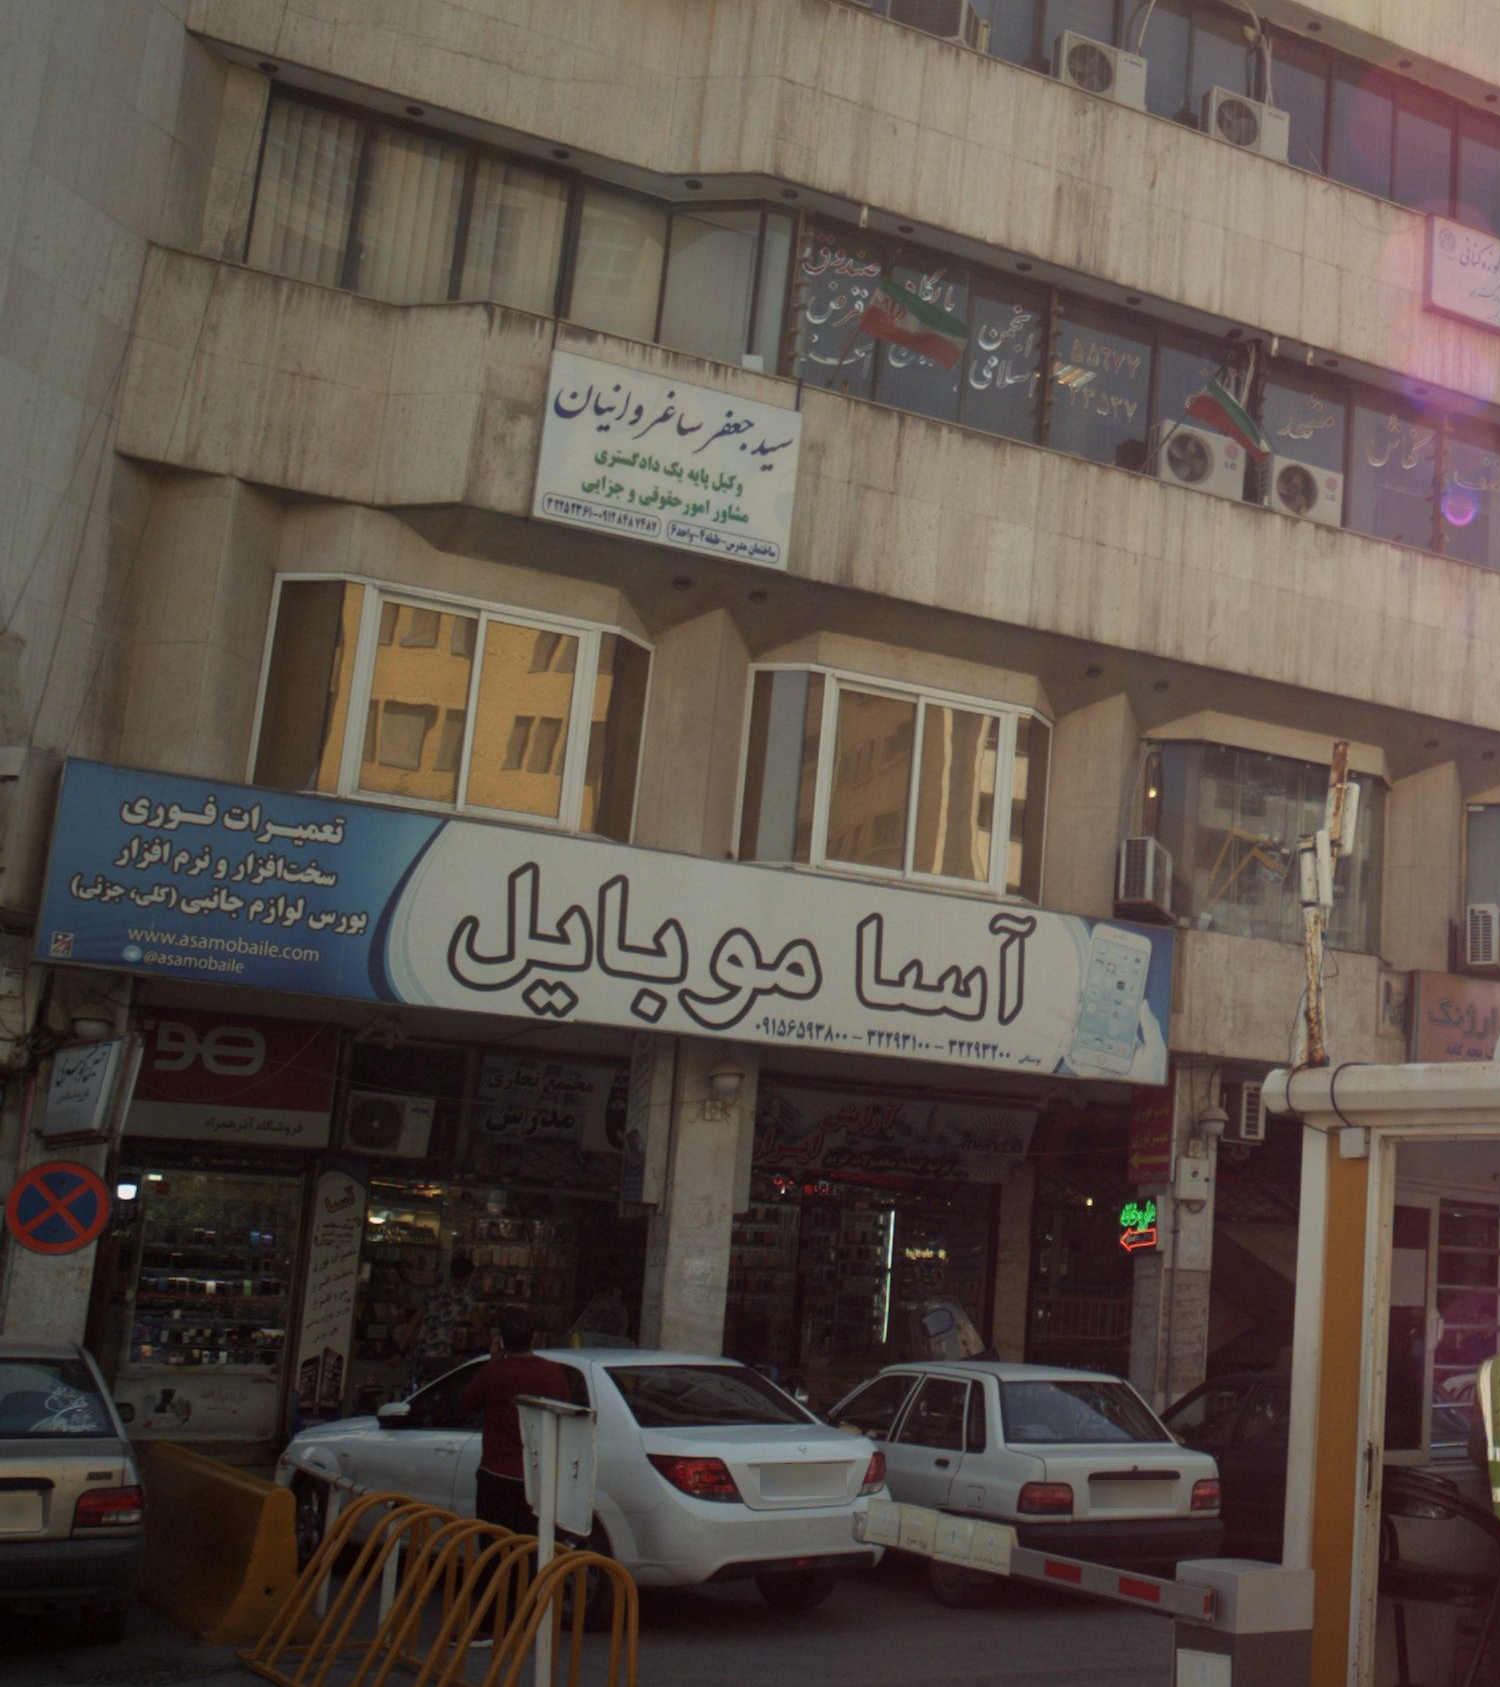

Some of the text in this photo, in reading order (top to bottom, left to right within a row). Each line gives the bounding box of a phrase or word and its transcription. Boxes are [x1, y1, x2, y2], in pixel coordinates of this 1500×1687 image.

[801, 235, 881, 277] صندوق
[806, 281, 869, 327] قرض
[968, 355, 1039, 398] اسلامی
[692, 409, 755, 455] جعفر
[751, 437, 794, 472] سید
[581, 475, 625, 498] جزایی
[594, 449, 744, 497] وکیل پایه یک دادگستری
[627, 489, 636, 503] و
[712, 505, 750, 524] مشاور
[119, 794, 346, 845] تعمیرات فوری
[113, 835, 172, 869] افزار
[171, 844, 211, 875] نرم
[213, 856, 228, 879] و
[179, 885, 245, 918] جانبی
[249, 895, 306, 927] لوازم
[306, 909, 369, 936] بورس
[127, 925, 320, 963] www.asamobaile.com
[447, 861, 1038, 1031] آسا موبایل
[143, 950, 245, 974] @asamobaile
[486, 1069, 540, 1092] تجاری
[485, 1107, 576, 1136] مدرس
